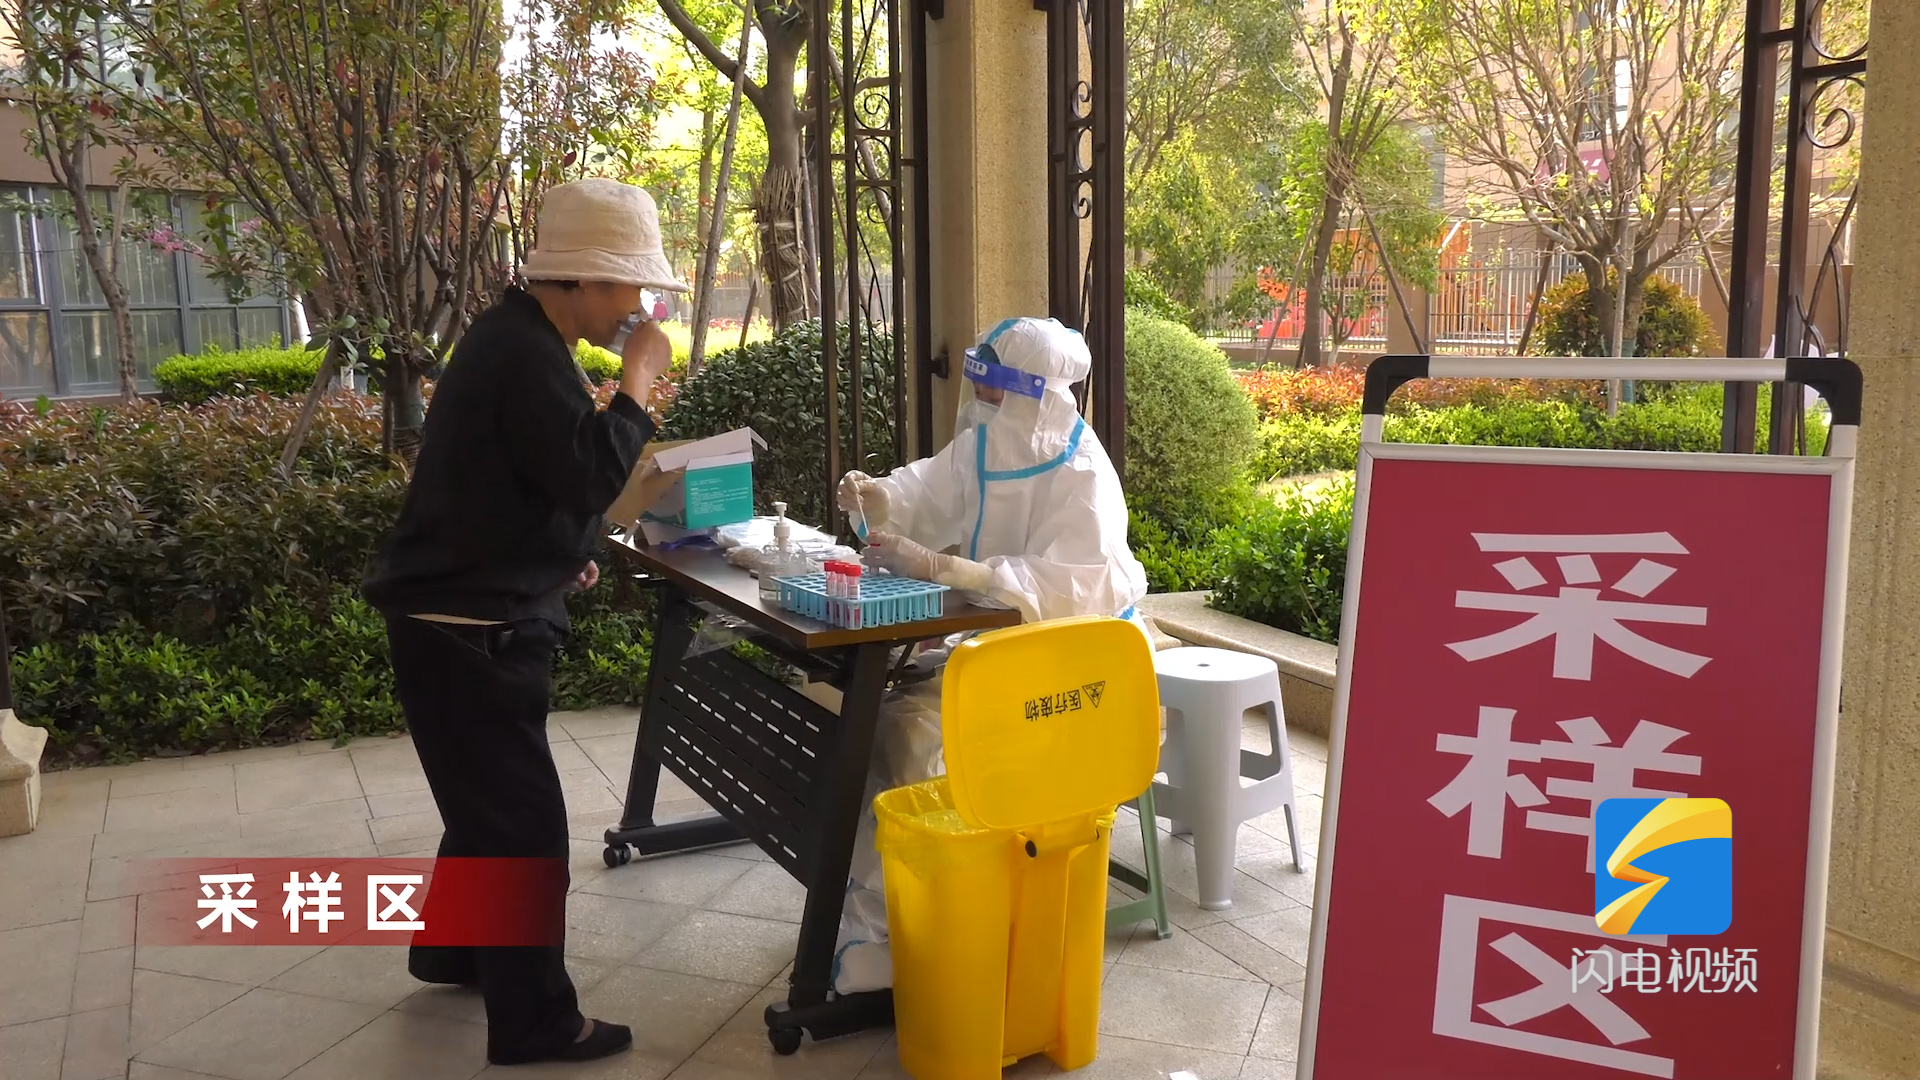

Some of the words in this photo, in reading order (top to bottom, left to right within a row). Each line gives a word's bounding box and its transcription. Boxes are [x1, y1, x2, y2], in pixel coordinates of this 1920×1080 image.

[1024, 689, 1082, 722] 医疗废物
[1427, 531, 1713, 1080] 采样区
